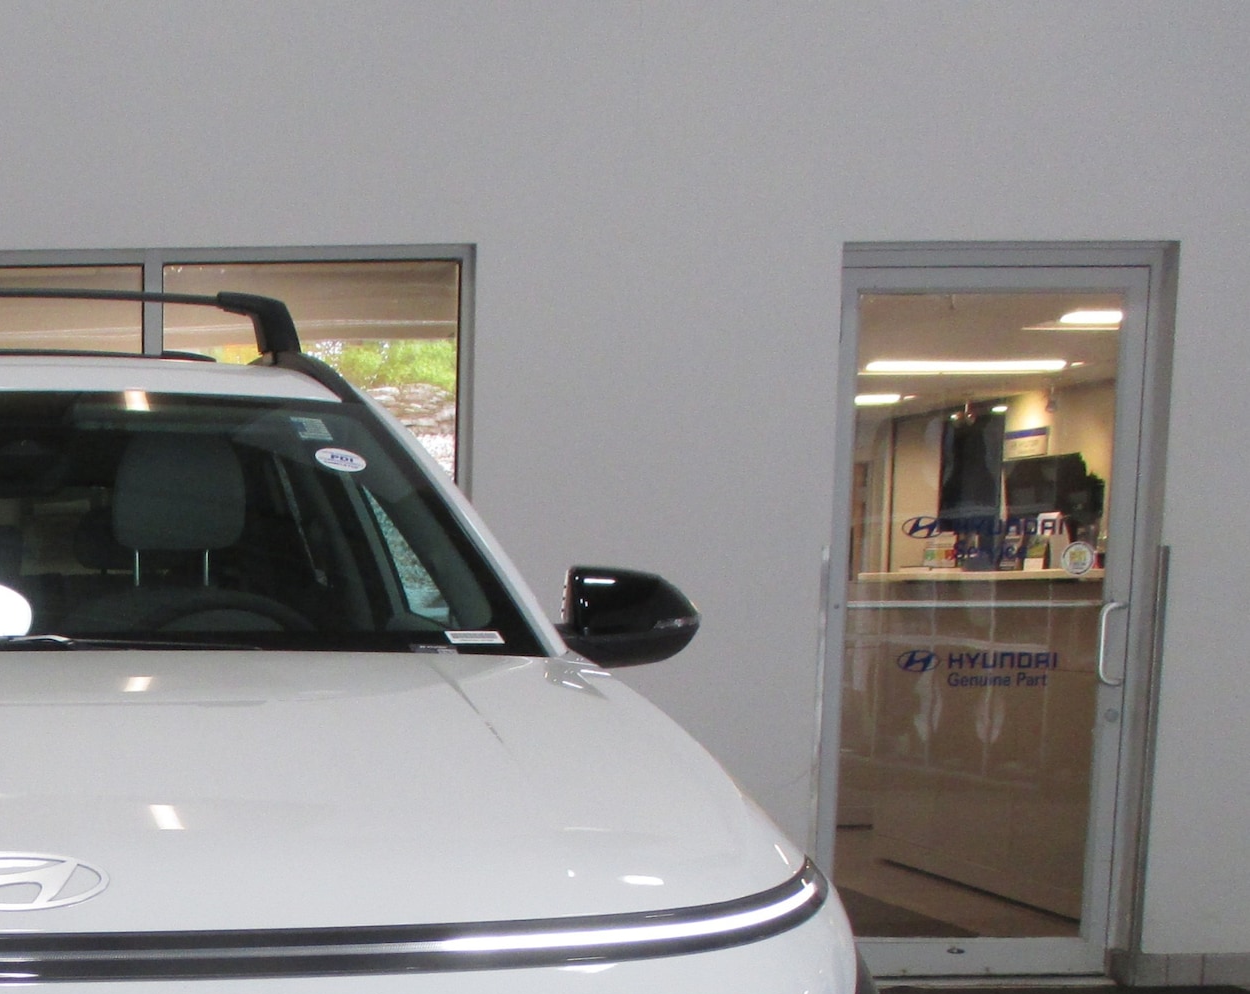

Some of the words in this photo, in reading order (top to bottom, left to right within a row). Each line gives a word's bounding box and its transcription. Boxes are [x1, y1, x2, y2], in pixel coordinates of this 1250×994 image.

[951, 518, 1063, 535] UNDAI
[947, 652, 1058, 669] HYUNDAI
[947, 672, 1011, 687] Genuine
